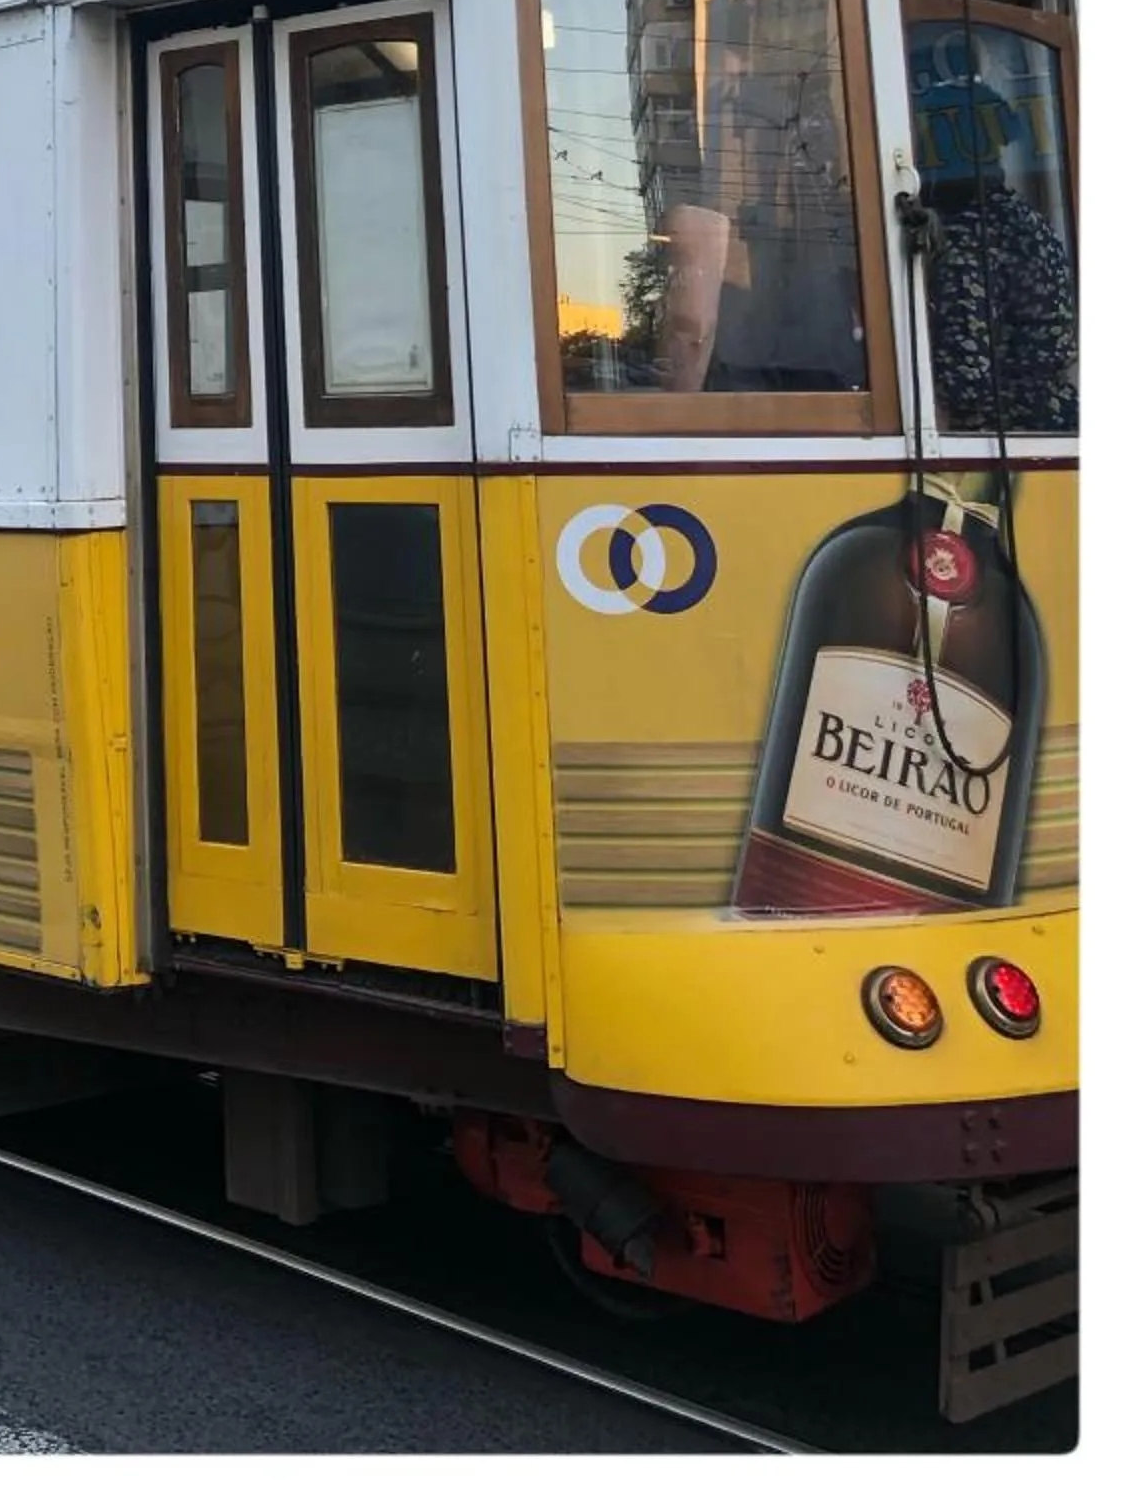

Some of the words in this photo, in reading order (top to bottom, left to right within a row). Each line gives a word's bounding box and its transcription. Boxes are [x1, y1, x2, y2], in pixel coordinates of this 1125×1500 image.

[875, 715, 936, 746] LICO
[827, 776, 836, 788] O
[839, 781, 880, 804] LICOR
[883, 795, 901, 811] DE
[906, 803, 971, 837] PORTUGAL
